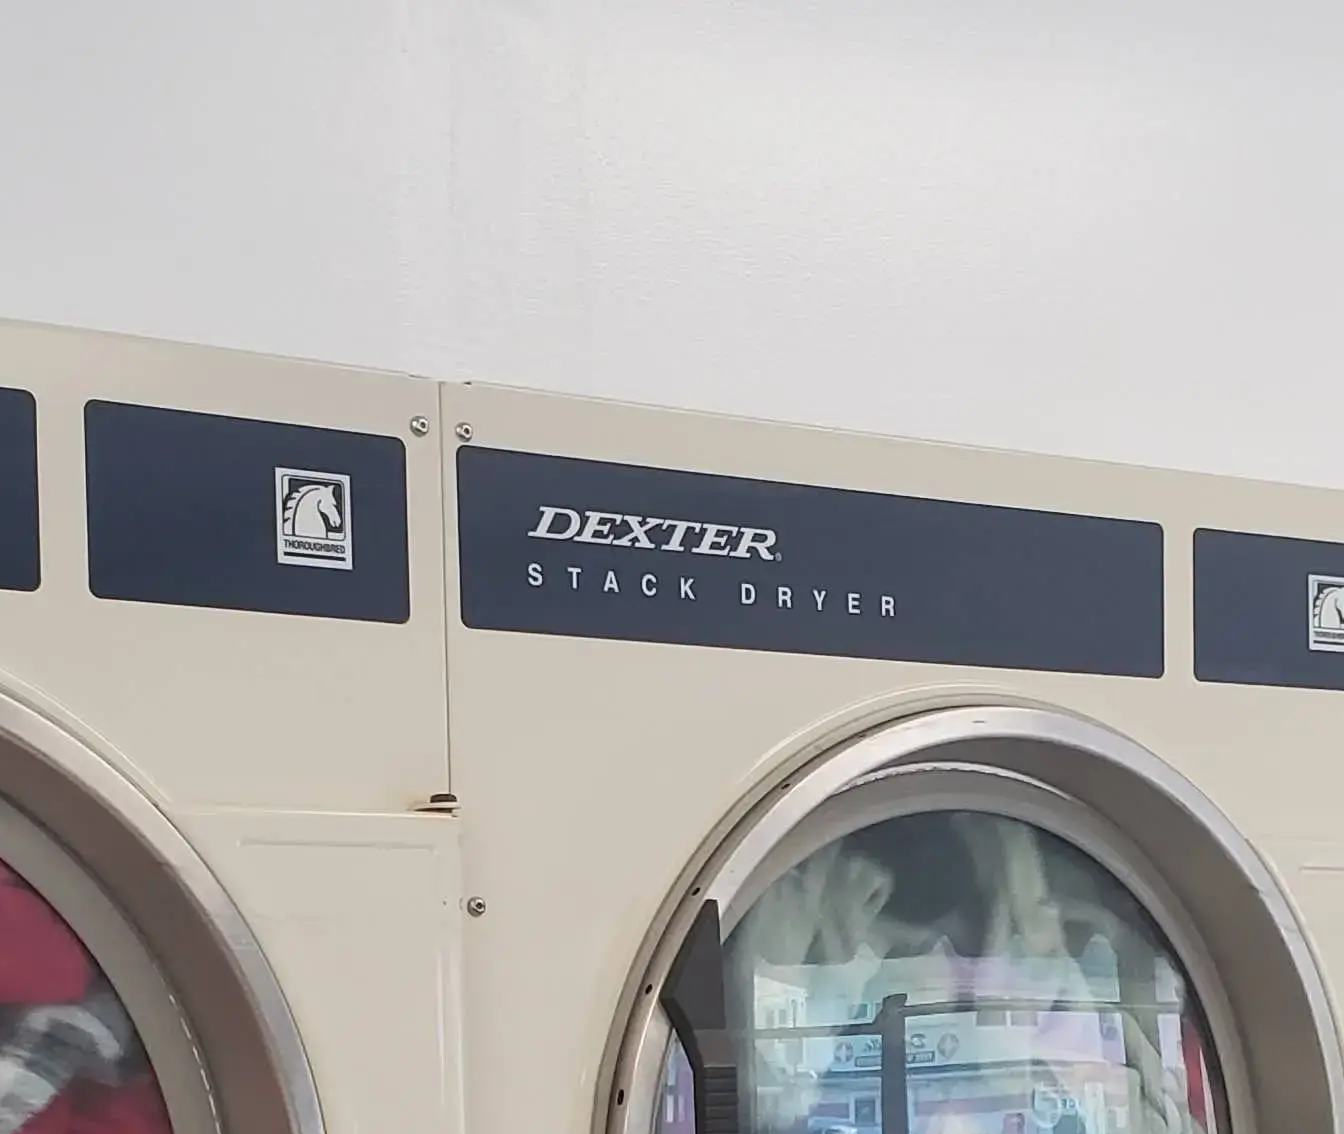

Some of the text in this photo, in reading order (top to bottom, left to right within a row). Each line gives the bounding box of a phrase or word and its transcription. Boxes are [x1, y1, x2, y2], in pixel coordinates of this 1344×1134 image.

[527, 506, 778, 561] DEXTER
[527, 563, 896, 617] STACK DRYER
